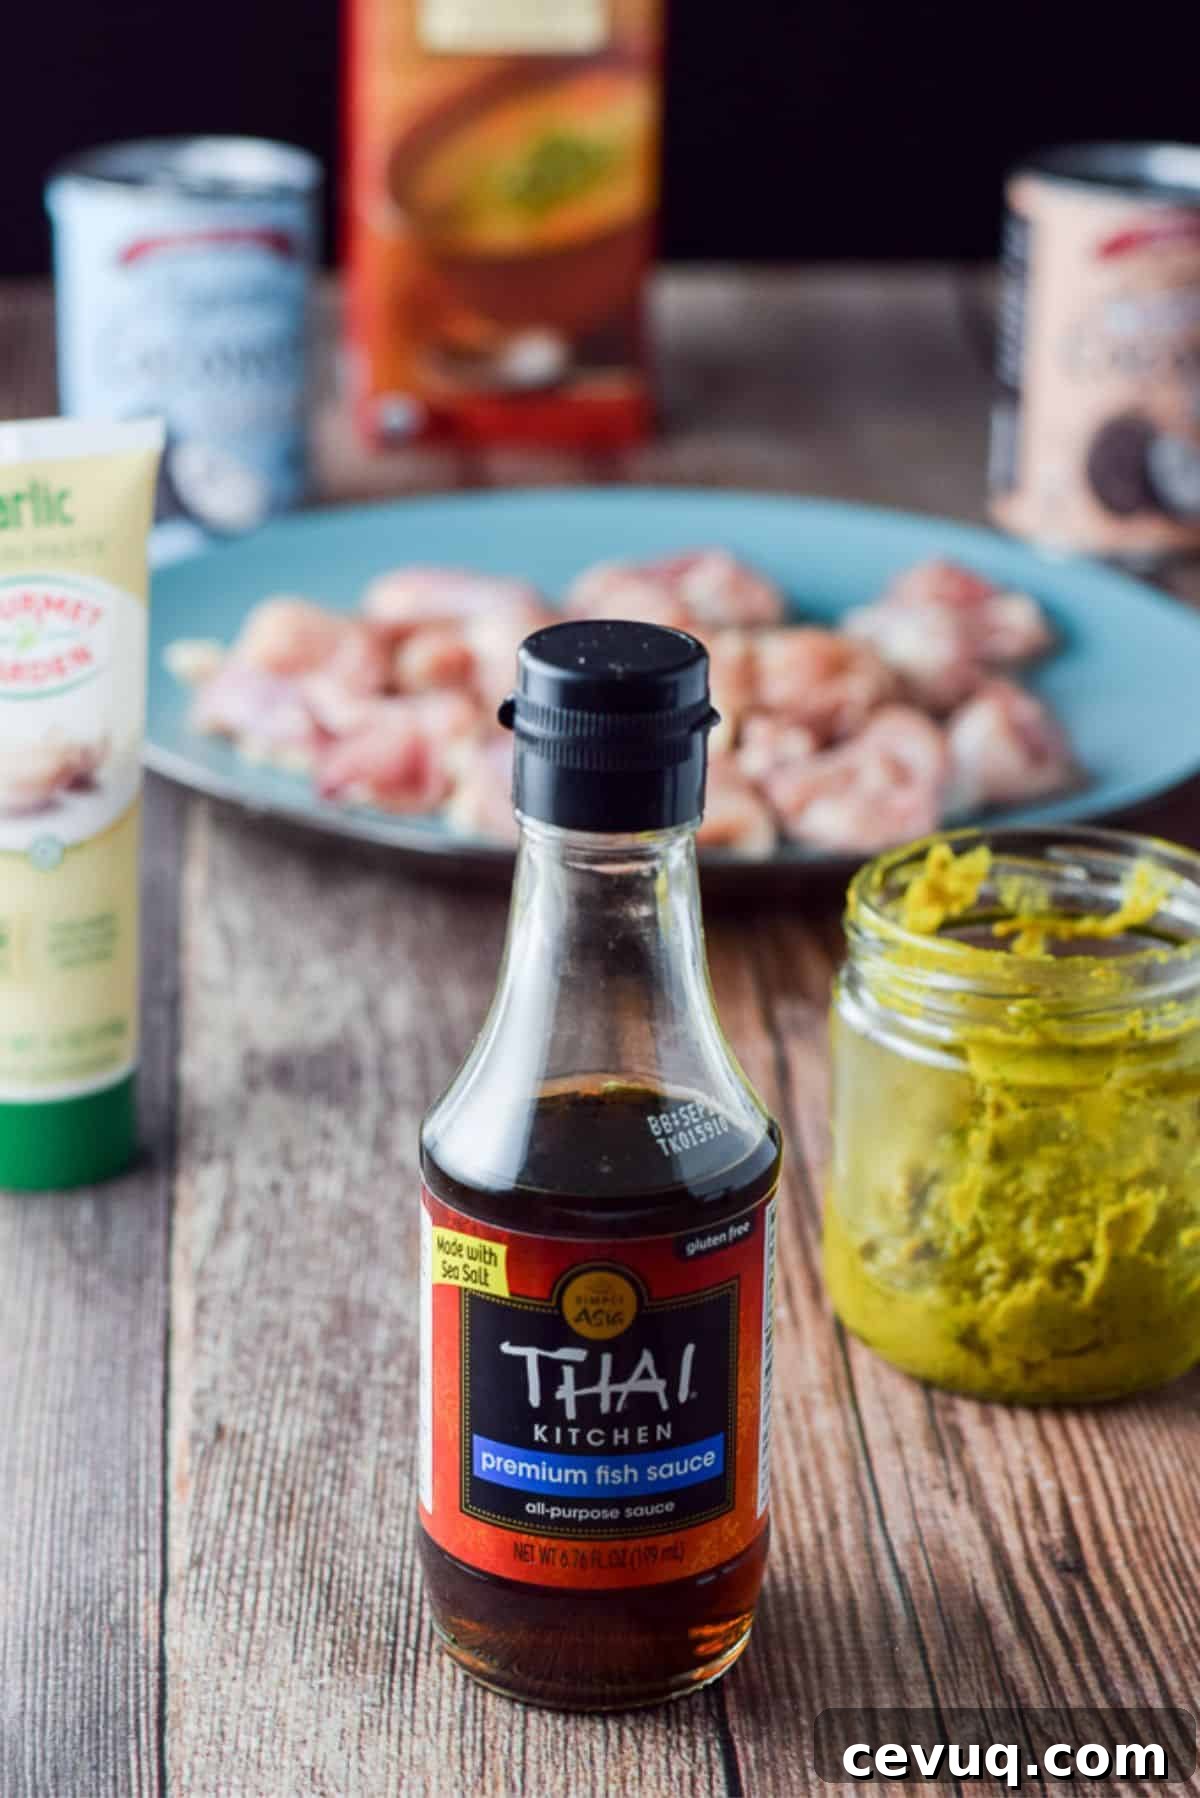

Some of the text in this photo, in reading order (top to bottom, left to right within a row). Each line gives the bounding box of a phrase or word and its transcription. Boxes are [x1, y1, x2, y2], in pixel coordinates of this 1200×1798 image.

[436, 1235, 497, 1267] Made with
[686, 1221, 750, 1256] gluten free
[441, 1260, 489, 1287] Sea Salt
[573, 1308, 625, 1328] ASIA
[500, 1341, 695, 1420] THAI
[534, 1422, 672, 1446] KITCHEN
[481, 1450, 716, 1486] premium fish sauce
[525, 1501, 675, 1521] all-purpose sauce
[513, 1541, 535, 1564] NET
[538, 1546, 557, 1567] WT
